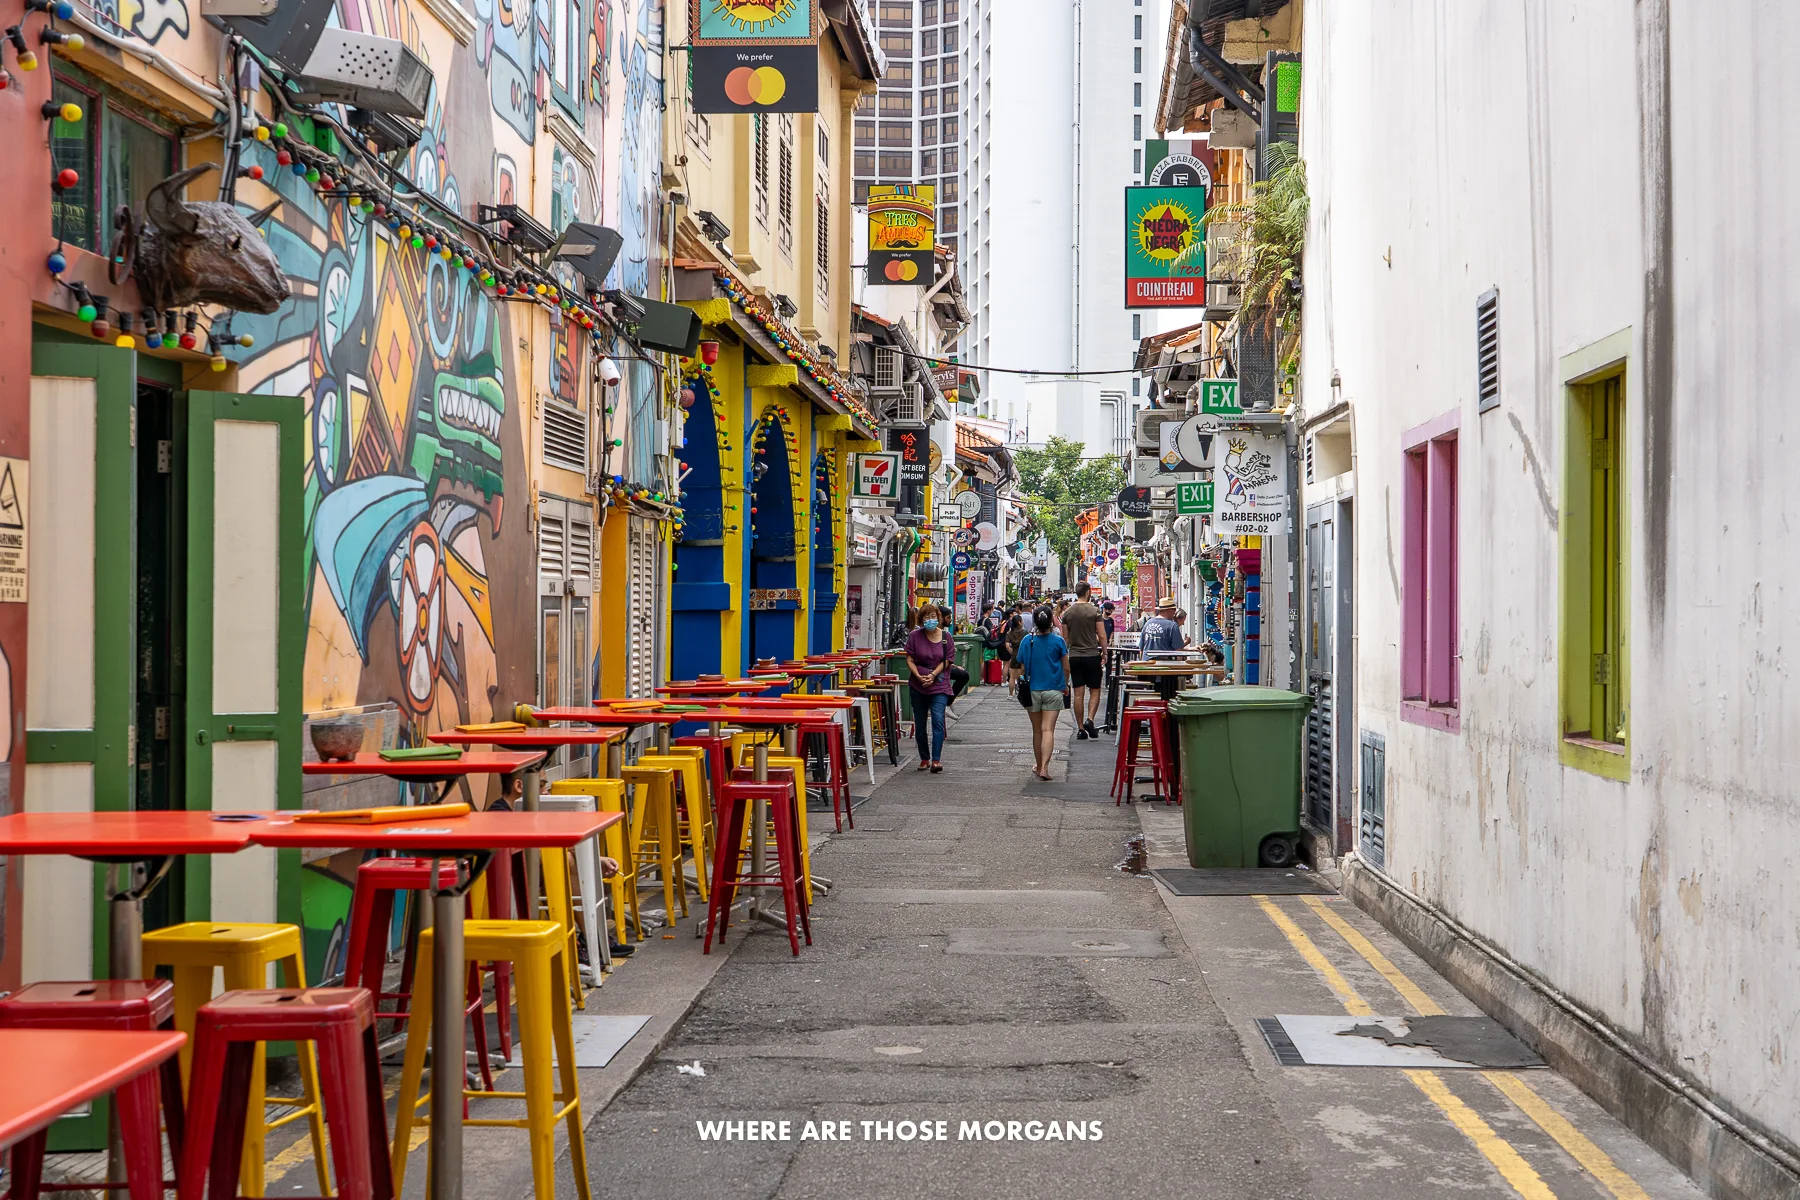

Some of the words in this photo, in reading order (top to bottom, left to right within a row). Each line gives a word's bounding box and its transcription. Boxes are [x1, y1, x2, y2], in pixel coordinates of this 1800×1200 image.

[750, 53, 774, 62] prefer
[1151, 160, 1170, 183] PIZZA
[1170, 155, 1208, 181] FABBRICA
[884, 212, 917, 227] TRES
[1143, 218, 1190, 233] PIEDRA
[877, 225, 926, 242] AMIGOS
[1145, 235, 1186, 249] NEGRA
[1136, 282, 1194, 297] COINTREAU
[932, 370, 955, 383] eryl's
[1208, 385, 1238, 408] EXI
[900, 464, 911, 472] AFT
[911, 464, 926, 472] BEER
[1181, 485, 1212, 502] EXIT
[1221, 512, 1282, 522] BARBERSHOP
[1235, 524, 1268, 533] #02-02
